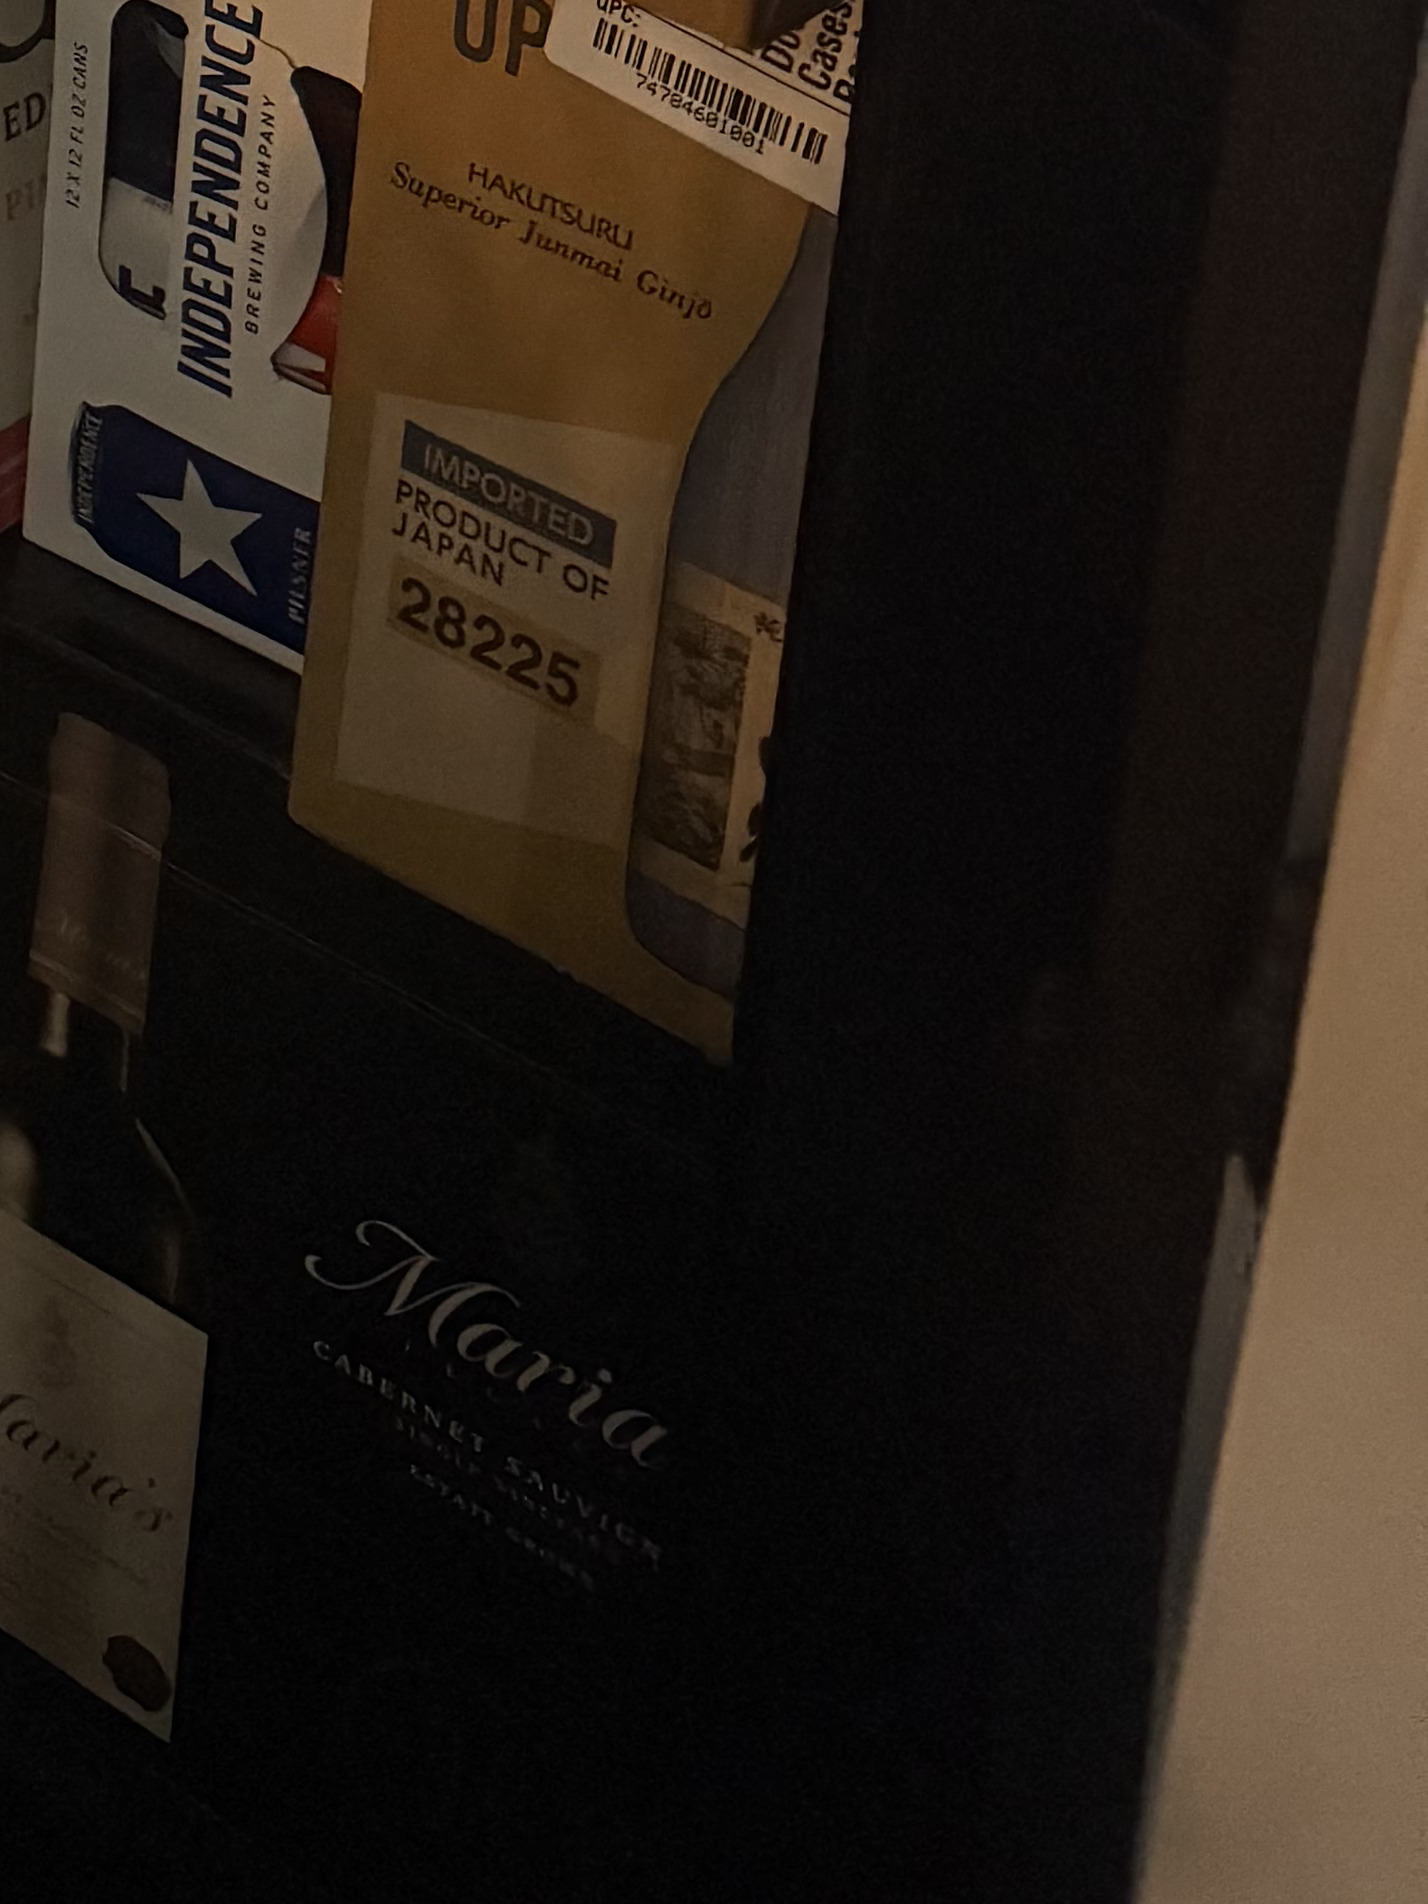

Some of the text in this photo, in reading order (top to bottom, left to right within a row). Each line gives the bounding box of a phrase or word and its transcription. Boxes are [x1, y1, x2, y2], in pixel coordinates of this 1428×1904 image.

[73, 40, 91, 92] CANS
[243, 93, 279, 336] BREWING COMPANY
[387, 159, 511, 231] Superior
[518, 216, 624, 284] Junmai
[467, 160, 635, 252] HAKUTSURU
[391, 511, 505, 588] JAPAN
[394, 478, 611, 602] PRODUCT OF
[423, 443, 595, 546] IMPORTED
[287, 526, 312, 625] PILSNER
[397, 576, 582, 708] 28225
[304, 1220, 670, 1470] Maria
[312, 1339, 486, 1454] CABERNET
